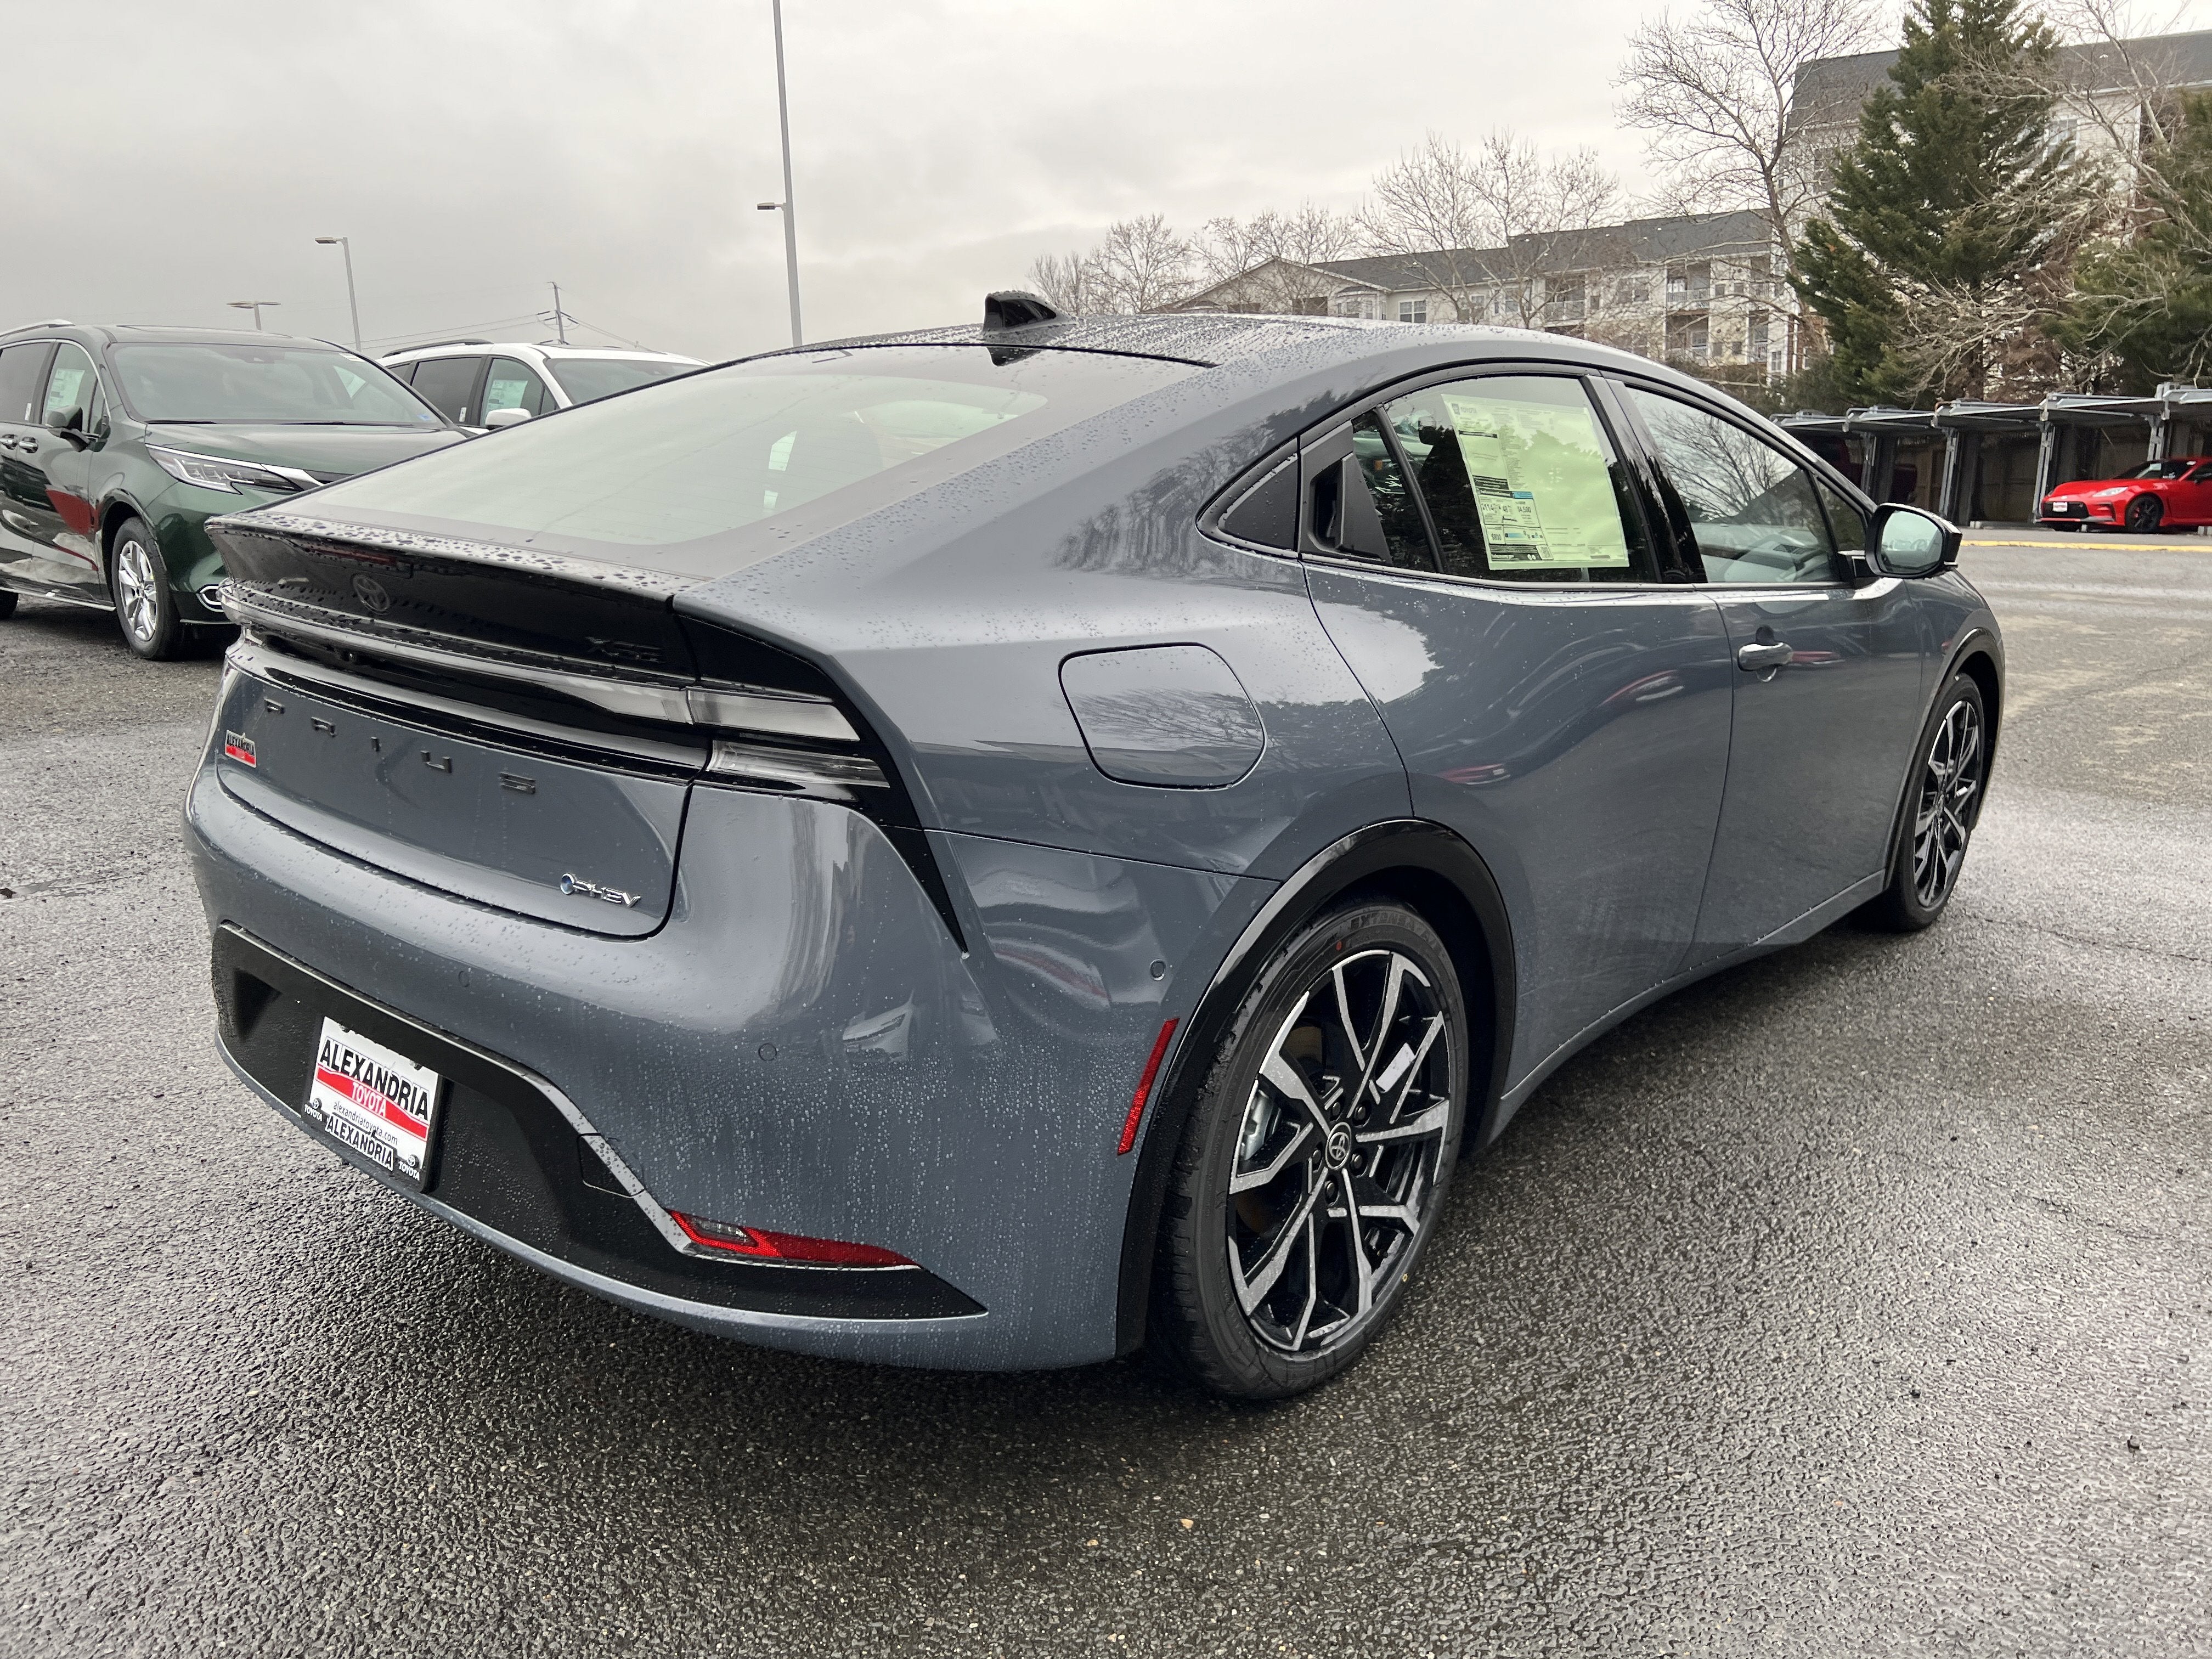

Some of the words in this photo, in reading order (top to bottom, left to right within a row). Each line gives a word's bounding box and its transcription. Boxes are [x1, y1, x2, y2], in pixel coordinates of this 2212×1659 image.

[264, 698, 536, 794] PRIUS
[319, 1039, 429, 1121] ALEXANDRIA
[352, 1081, 386, 1118] TOYOTA
[304, 1104, 323, 1121] TOYOTA
[334, 1100, 398, 1146] alexandriatoyota.com
[325, 1115, 393, 1170] ALEXANDRIA
[399, 1161, 420, 1181] TOYOTA
